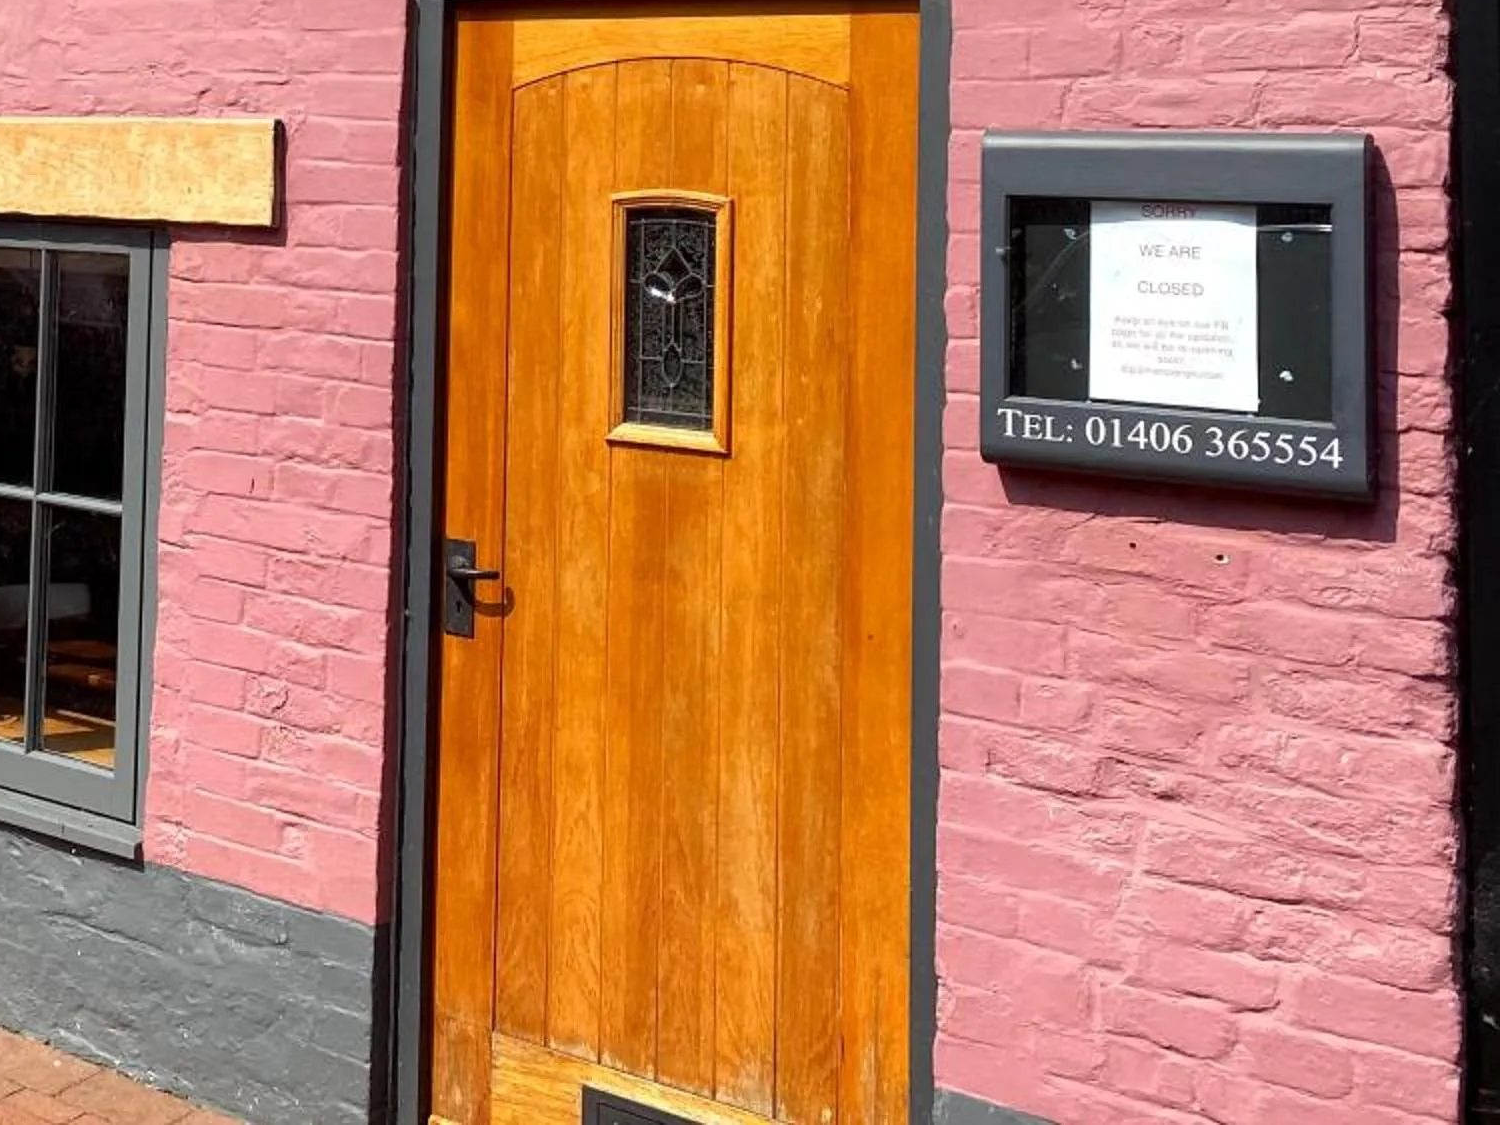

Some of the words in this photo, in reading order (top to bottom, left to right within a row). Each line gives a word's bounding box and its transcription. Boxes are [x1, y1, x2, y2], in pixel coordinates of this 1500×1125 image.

[1140, 204, 1198, 220] SORRY
[1139, 244, 1164, 258] WE
[1169, 246, 1202, 260] ARE
[1137, 280, 1205, 297] CLOSED
[997, 408, 1074, 443] TEL:
[1085, 416, 1194, 454] 01406
[1205, 426, 1344, 469] 365554
